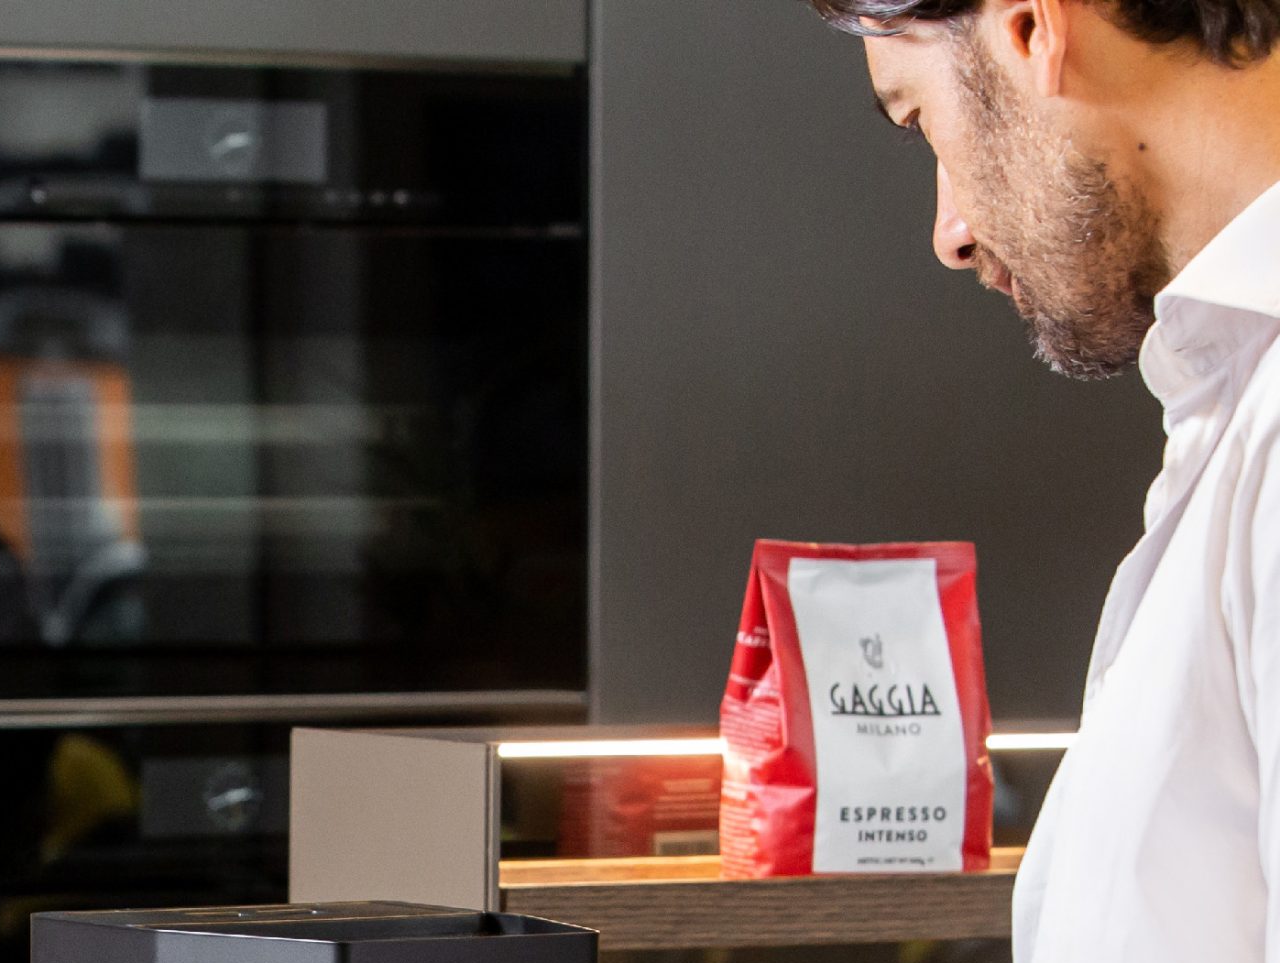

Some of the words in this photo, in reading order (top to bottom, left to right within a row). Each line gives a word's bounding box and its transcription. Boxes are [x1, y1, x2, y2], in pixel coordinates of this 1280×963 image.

[830, 683, 941, 716] GAGGIA
[857, 722, 921, 736] MILANO
[840, 807, 947, 822] ESPRESSO
[858, 830, 927, 842] INTENSO
